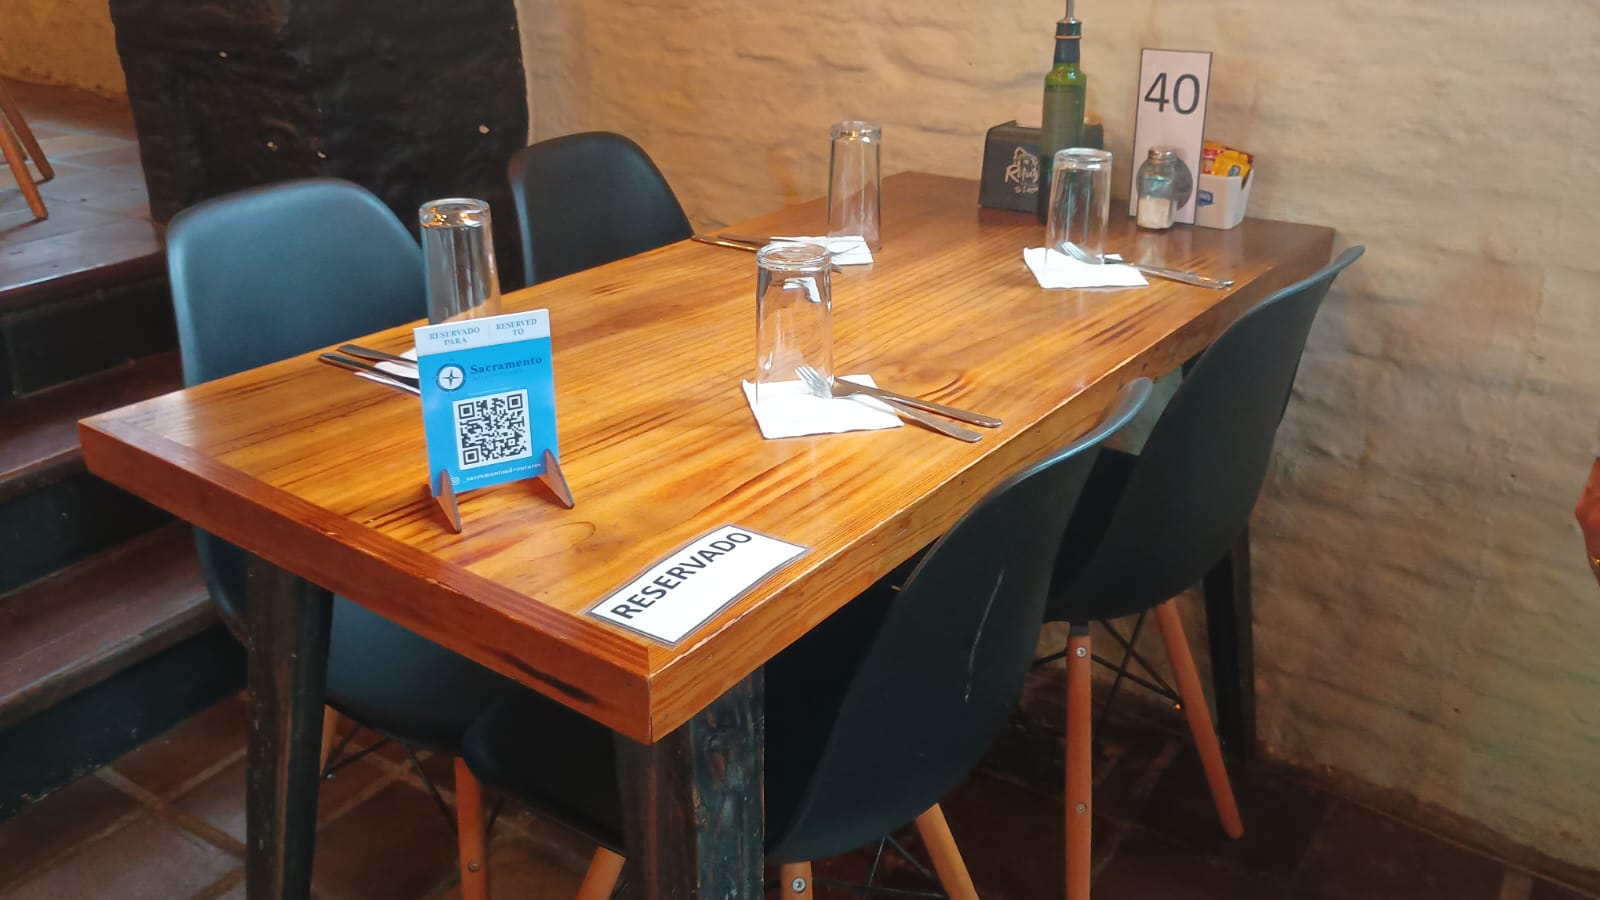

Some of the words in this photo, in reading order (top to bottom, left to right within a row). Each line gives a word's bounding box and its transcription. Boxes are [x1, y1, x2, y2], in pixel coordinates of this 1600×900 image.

[1143, 72, 1200, 115] 40
[496, 318, 537, 330] RESERVED
[429, 326, 481, 341] RESERVADO
[513, 328, 525, 336] TO
[444, 336, 468, 346] PARA
[470, 356, 543, 375] Sacramento
[610, 532, 752, 619] RESERVADO
